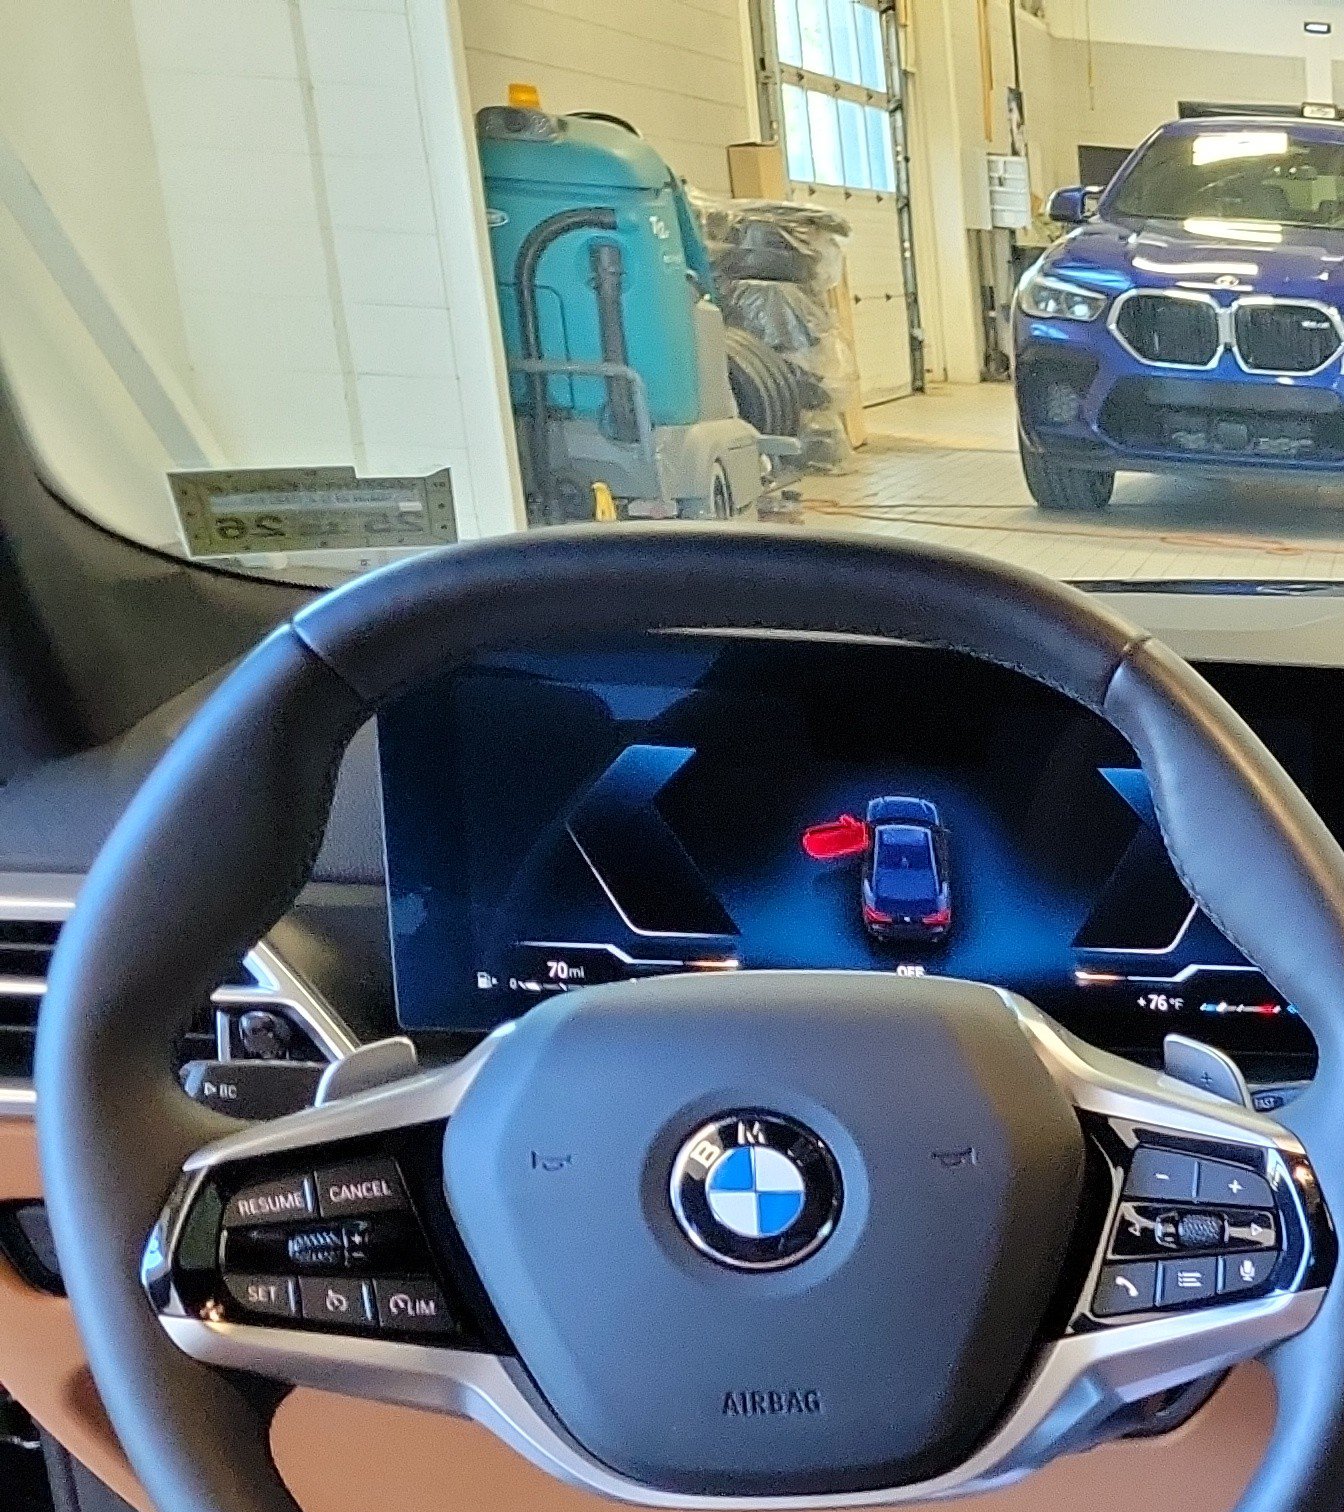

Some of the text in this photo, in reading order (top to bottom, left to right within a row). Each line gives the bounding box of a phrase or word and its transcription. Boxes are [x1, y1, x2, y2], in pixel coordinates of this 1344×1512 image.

[237, 1190, 305, 1217] RESUME
[329, 1178, 392, 1203] CANCEL
[248, 1285, 277, 1303] SET
[722, 1389, 822, 1417] AIRBAG
